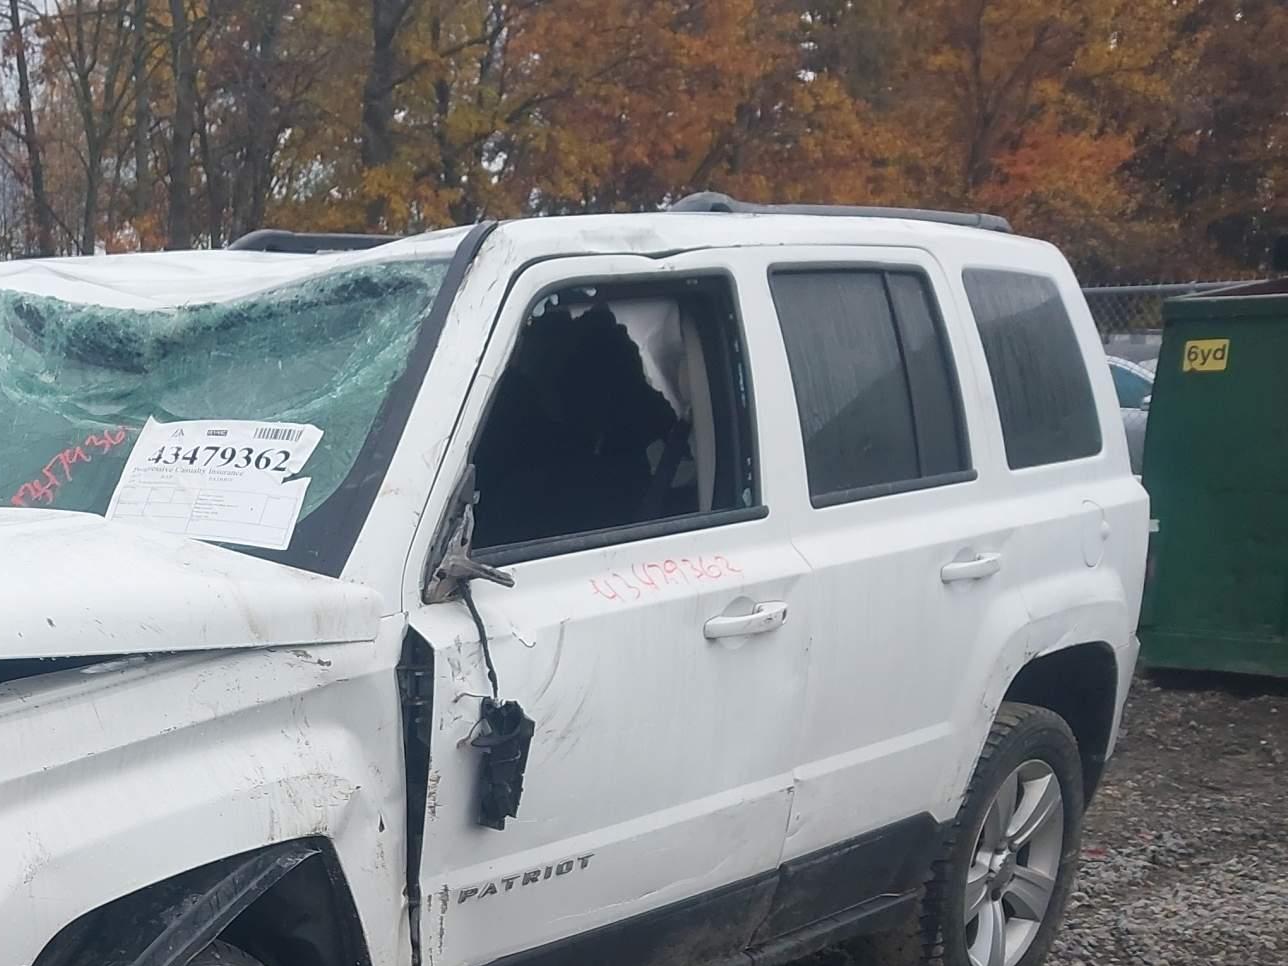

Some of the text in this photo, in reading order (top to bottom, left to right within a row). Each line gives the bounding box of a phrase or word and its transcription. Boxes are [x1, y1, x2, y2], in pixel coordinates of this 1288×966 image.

[1187, 343, 1227, 365] 6yd
[148, 445, 291, 472] 43479362
[174, 466, 206, 475] Casualty
[208, 469, 244, 477] Insurance
[457, 853, 596, 904] PATRIOT
